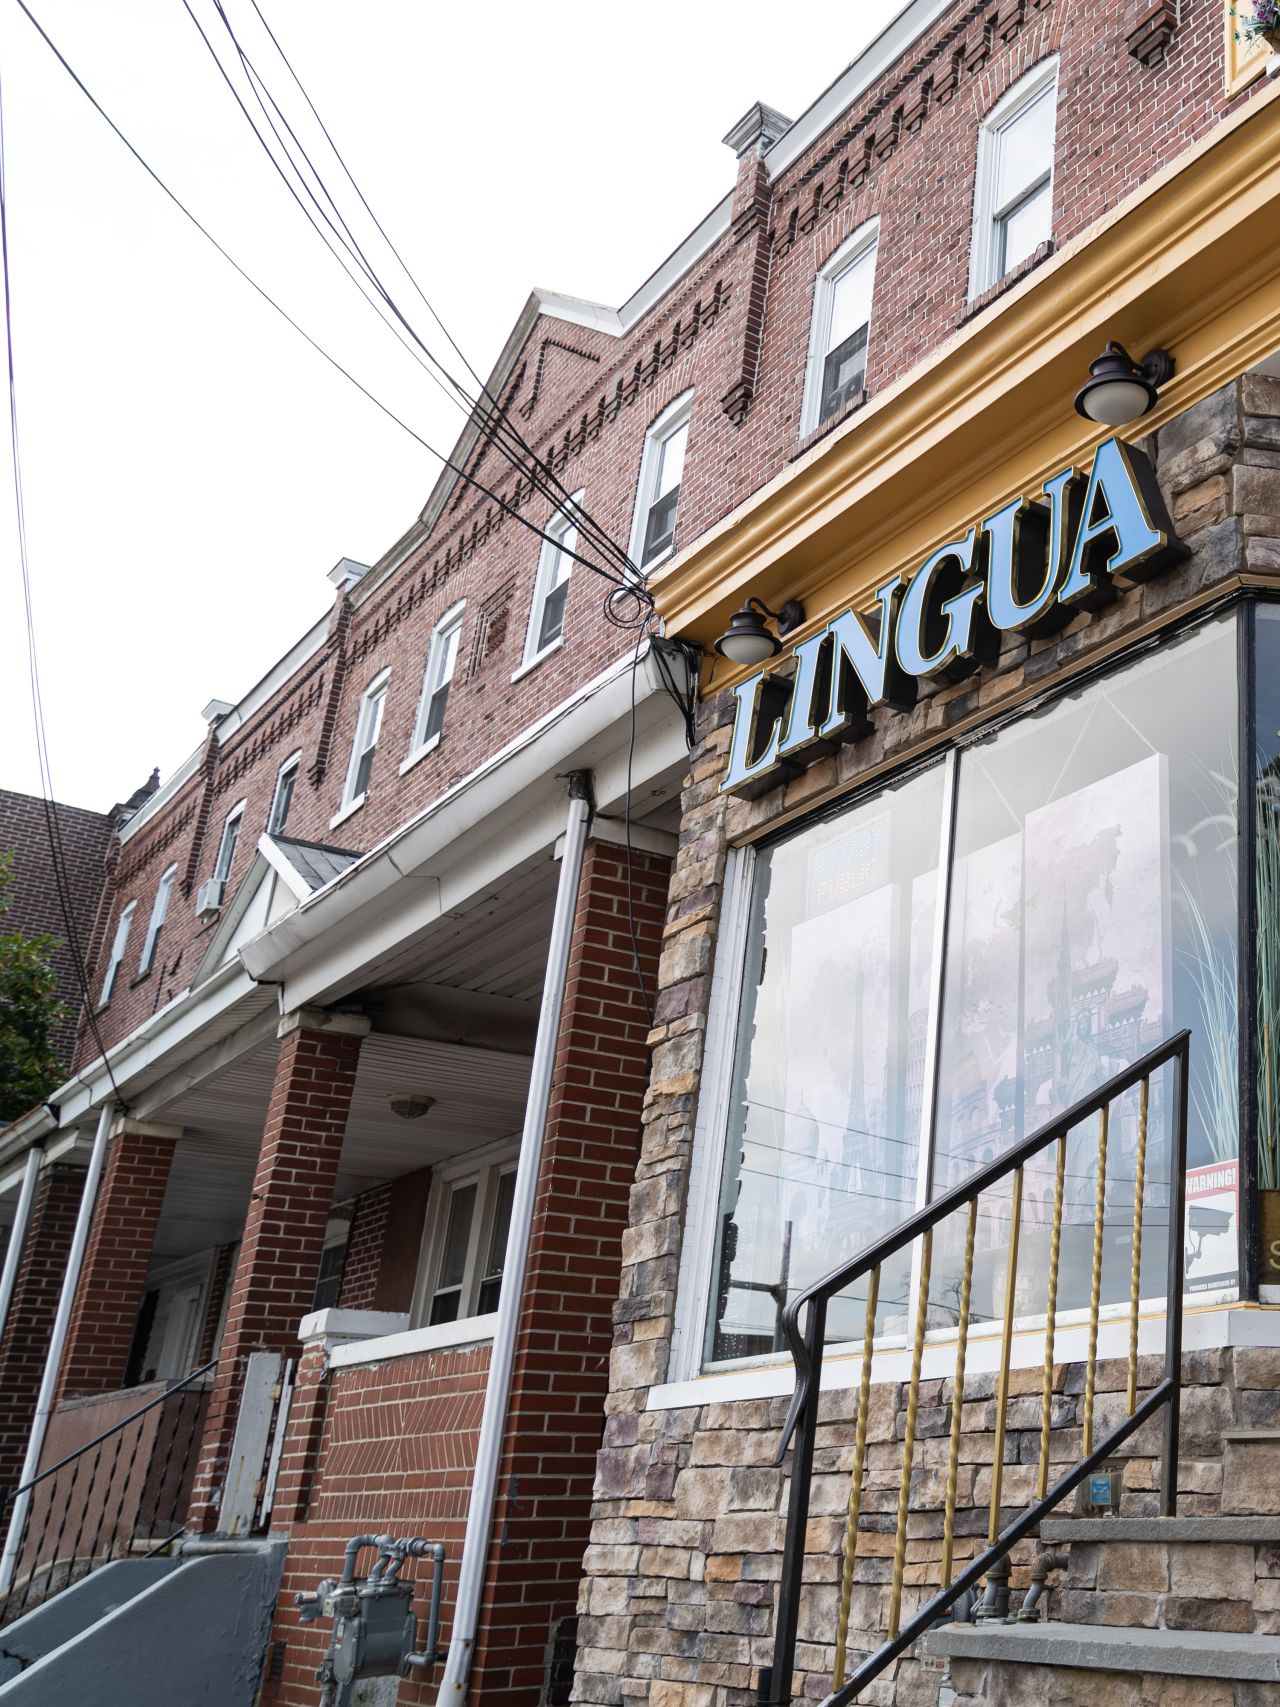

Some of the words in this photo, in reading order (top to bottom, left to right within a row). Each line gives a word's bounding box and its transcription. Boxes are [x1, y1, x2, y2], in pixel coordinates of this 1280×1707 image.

[718, 435, 1170, 798] LINGUA
[818, 857, 877, 904] PUBLIC
[1186, 1168, 1236, 1195] WARNING!
